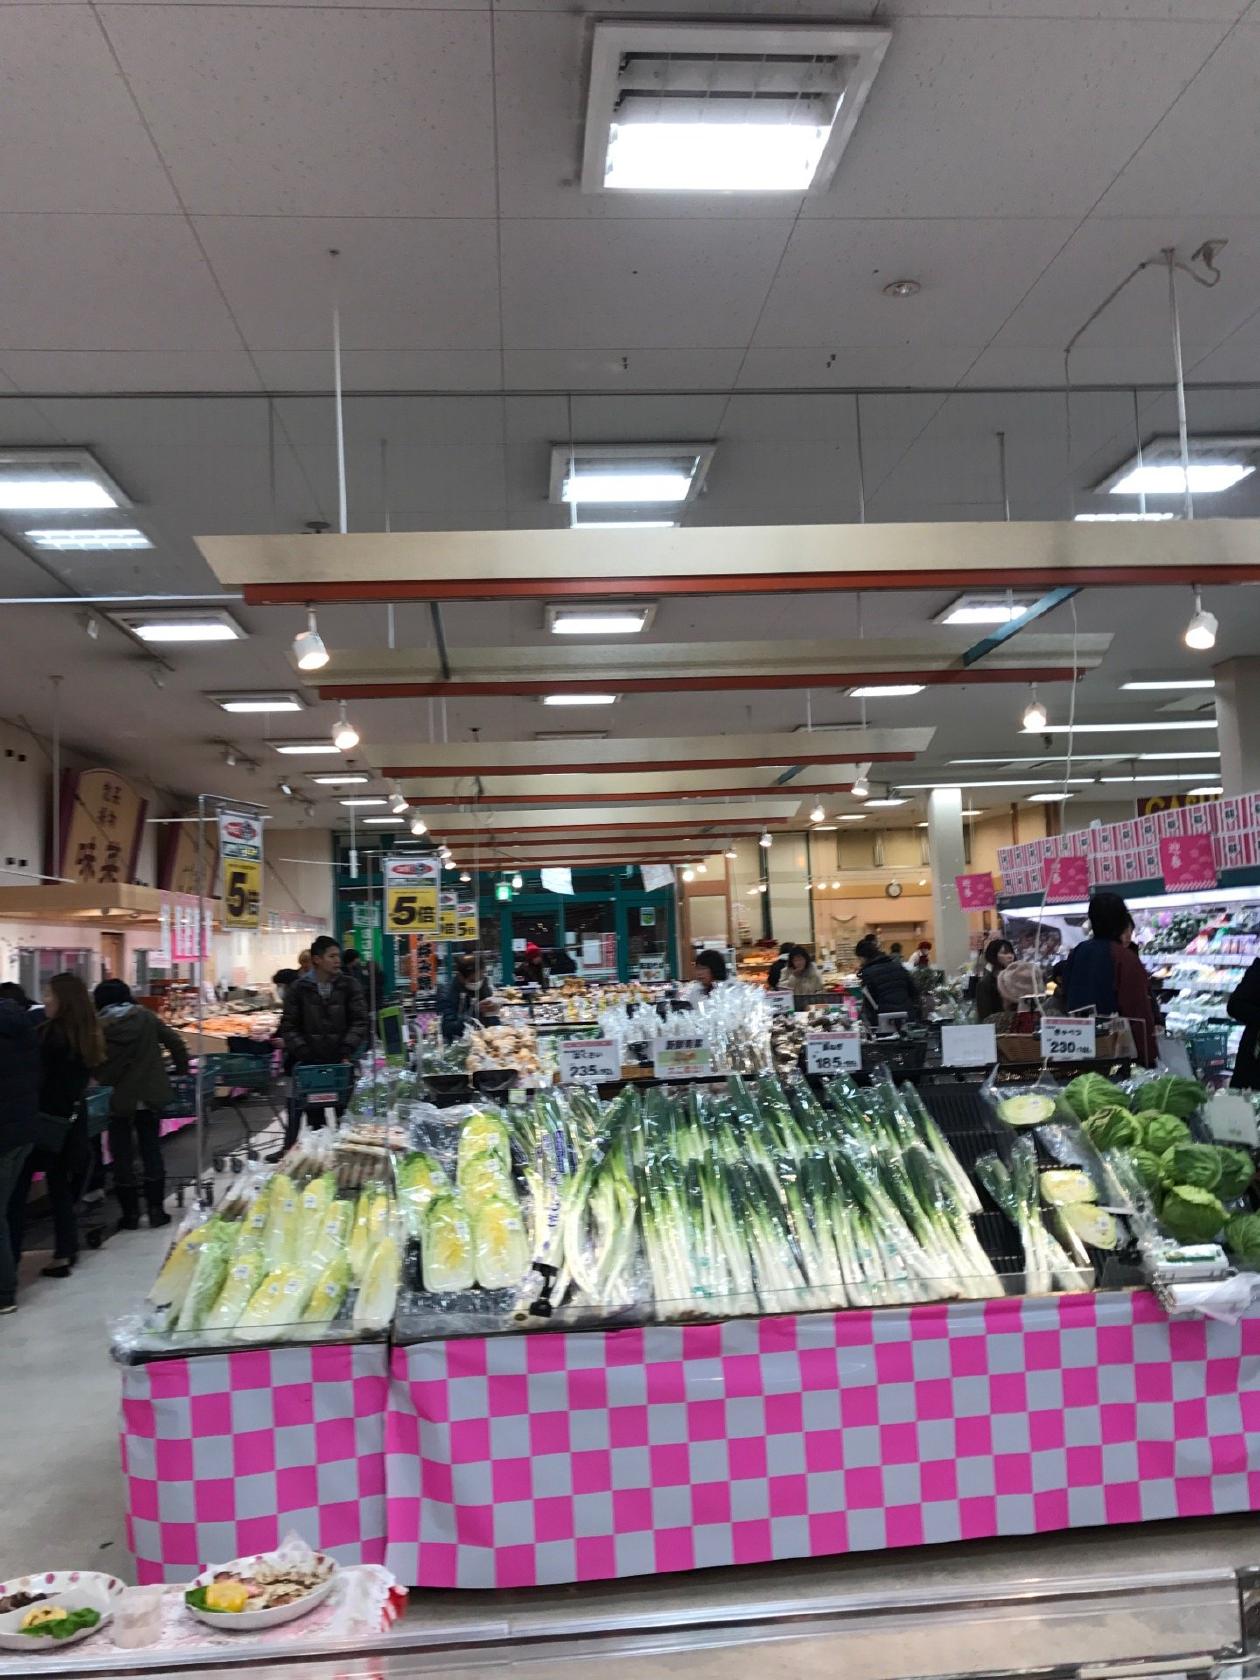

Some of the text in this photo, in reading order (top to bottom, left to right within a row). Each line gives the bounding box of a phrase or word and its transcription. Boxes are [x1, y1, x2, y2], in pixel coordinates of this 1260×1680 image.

[391, 896, 435, 926] 5倍
[1050, 1041, 1075, 1053] 230
[815, 1057, 842, 1069] 185
[570, 1065, 597, 1077] 235
